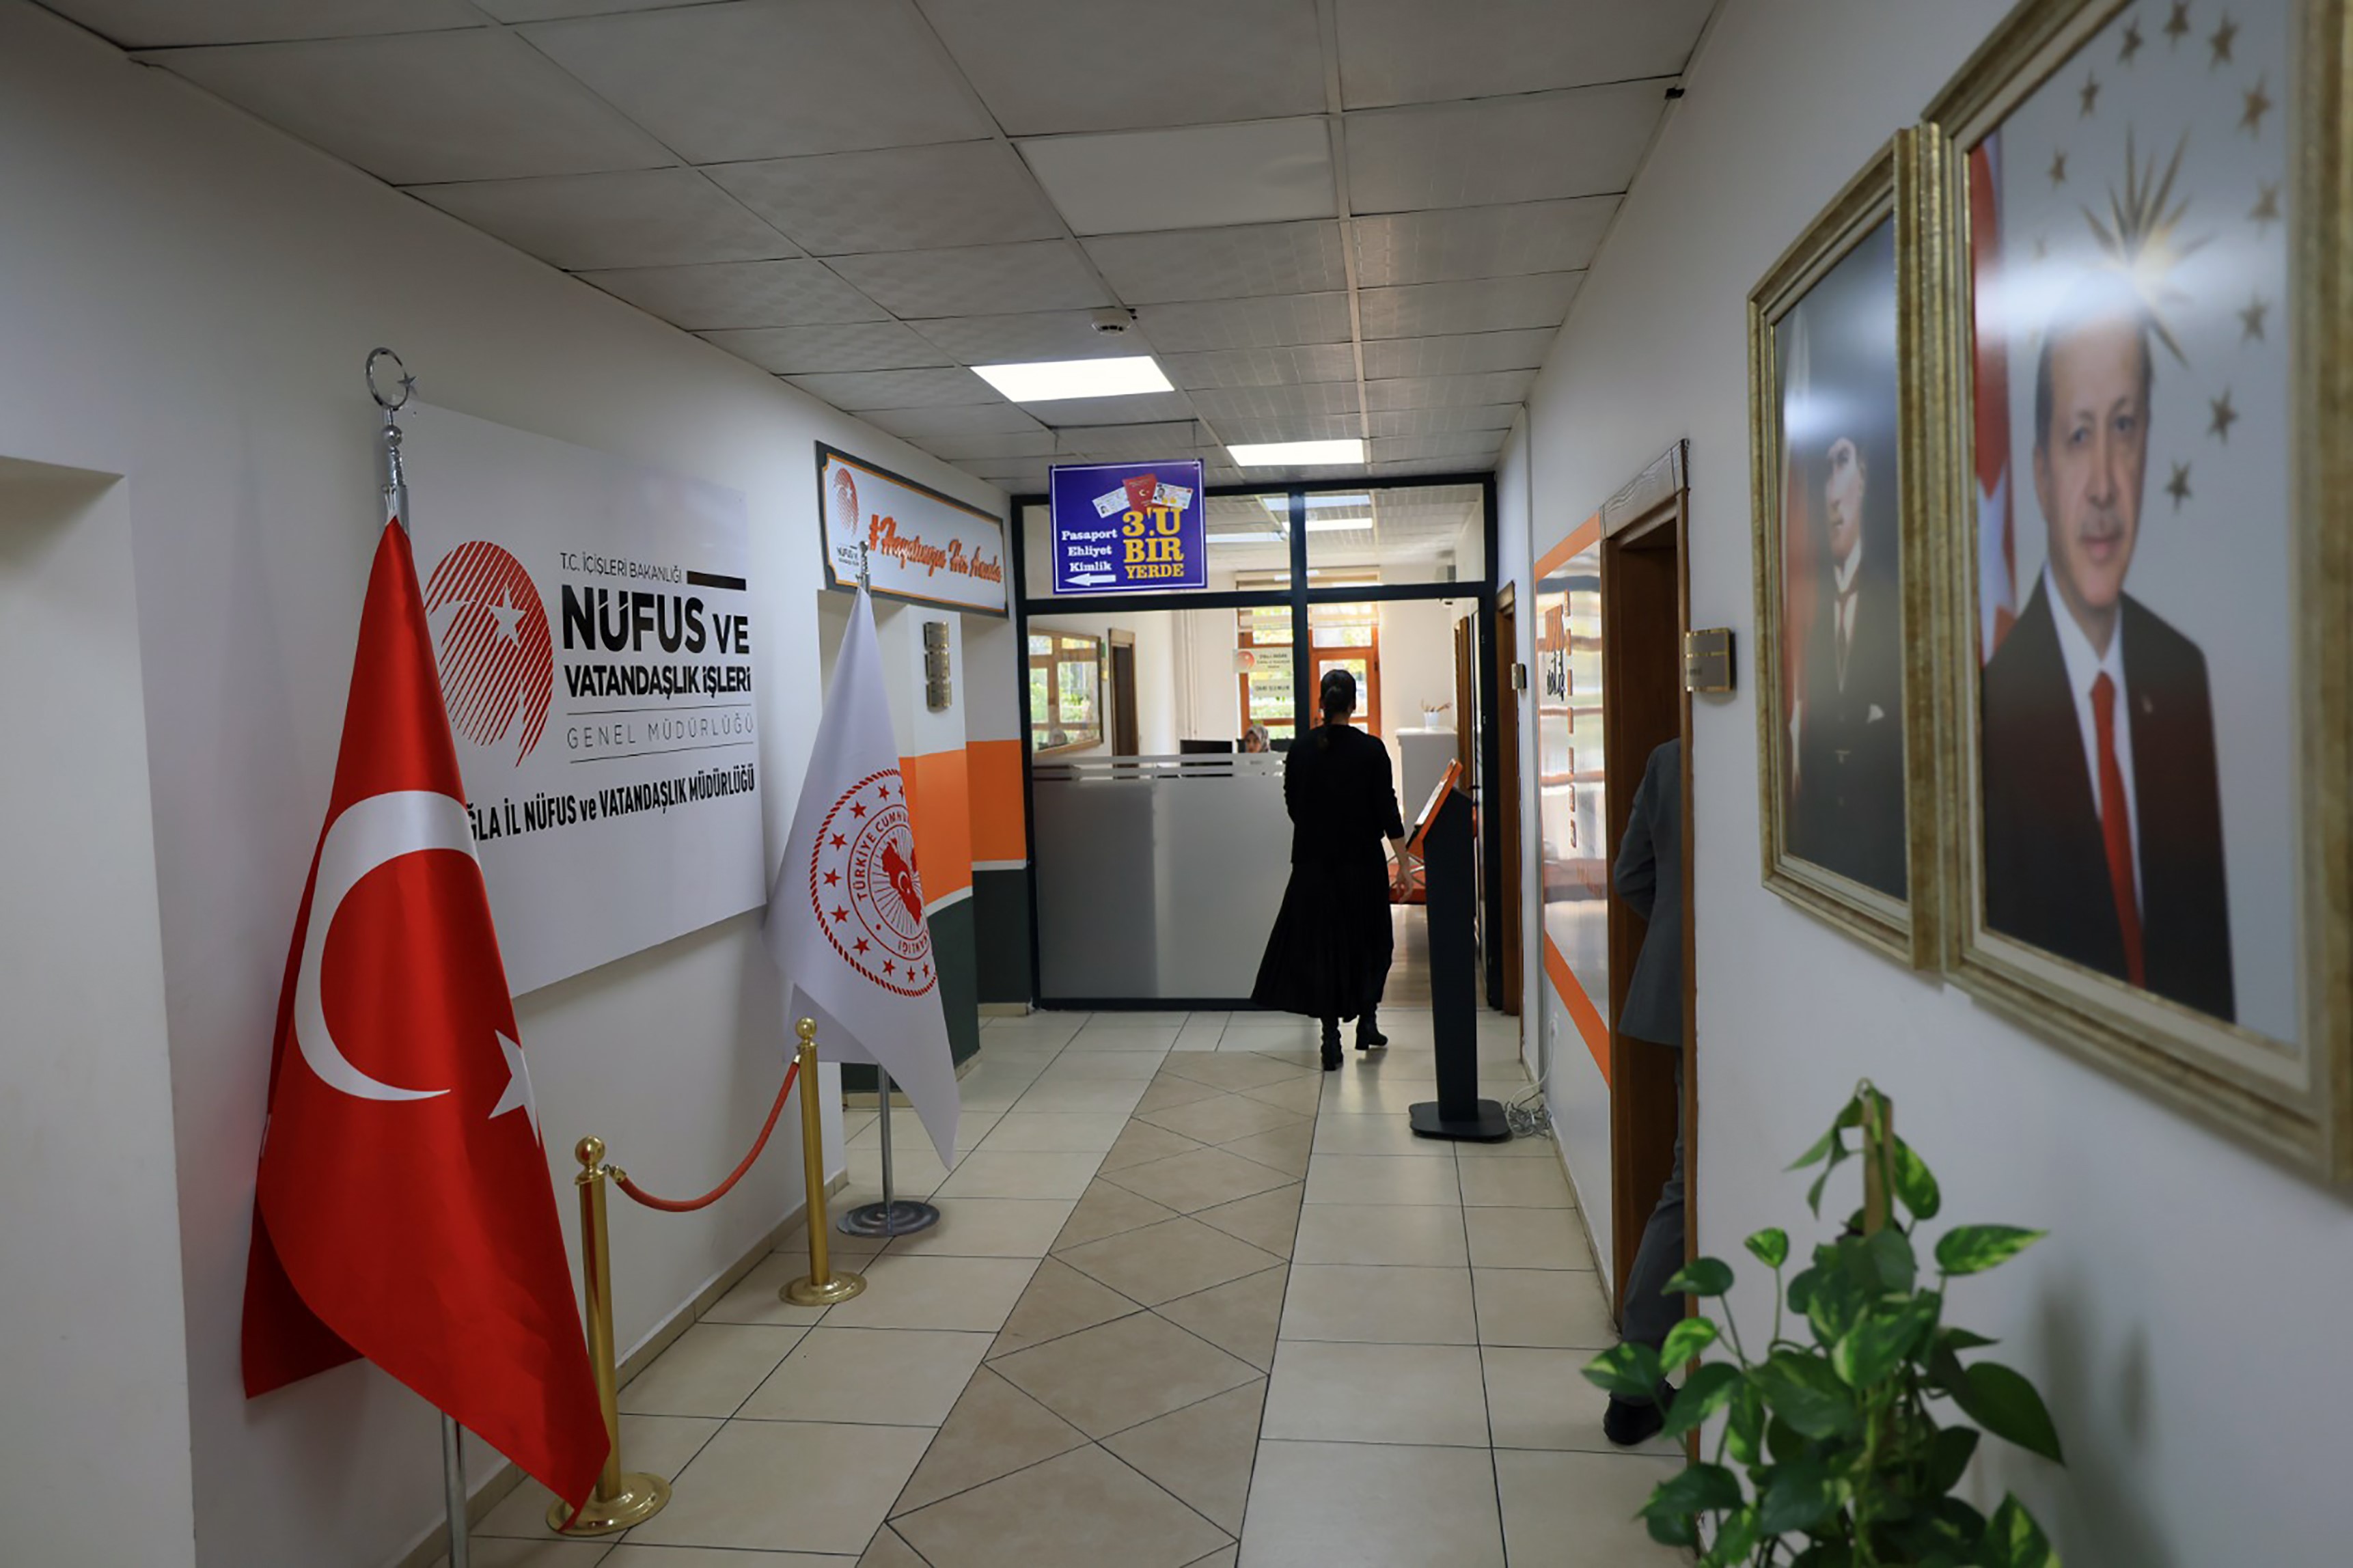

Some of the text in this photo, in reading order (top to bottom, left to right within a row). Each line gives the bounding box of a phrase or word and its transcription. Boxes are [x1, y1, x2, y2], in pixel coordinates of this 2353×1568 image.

[1061, 529, 1118, 542] Pasaport
[1068, 545, 1112, 558] Ehliyet
[560, 551, 682, 583] T.C. İÇİŞLERİ BAKANLIĞI
[1069, 561, 1112, 573] Kimlik
[1125, 564, 1184, 579] YERDE
[561, 584, 749, 654] NÜFUS VE
[564, 665, 752, 700] VATANDAŞLIK İŞLERİ
[566, 713, 754, 749] GENEL MÜDÜRLÜĞÜ
[467, 762, 754, 841] ĞLA İL NÜFUS ve VATANDAŞLIK MÜDÜRLÜĞÜ
